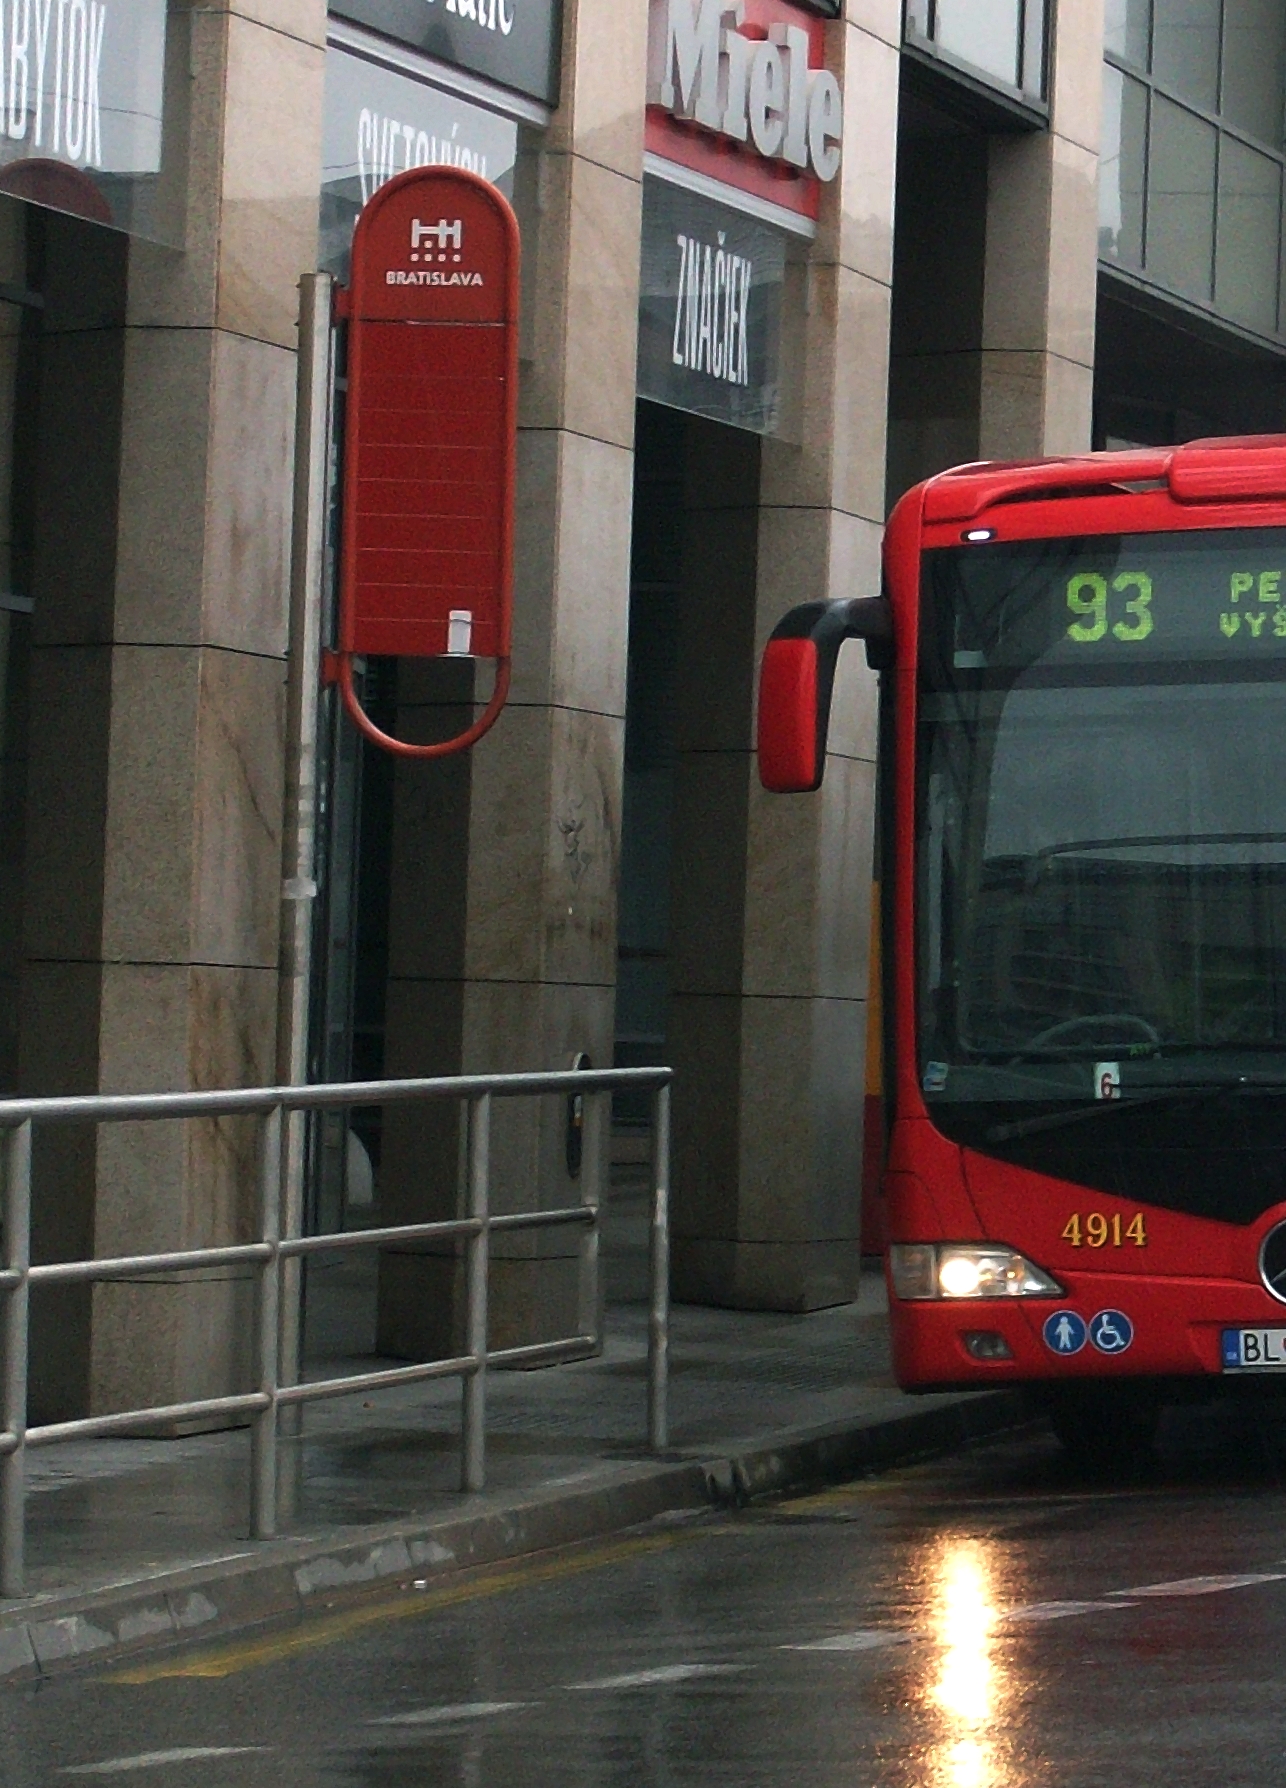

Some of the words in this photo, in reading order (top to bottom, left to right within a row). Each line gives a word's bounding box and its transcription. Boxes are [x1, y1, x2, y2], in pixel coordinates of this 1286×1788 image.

[0, 0, 106, 167] BYTOK
[660, 0, 843, 182] Miele
[386, 271, 483, 286] BRATISLAVA
[672, 230, 751, 387] ZNAČIEK
[1066, 571, 1153, 642] 93
[1061, 1212, 1147, 1248] 4914
[1243, 1333, 1281, 1362] BL
